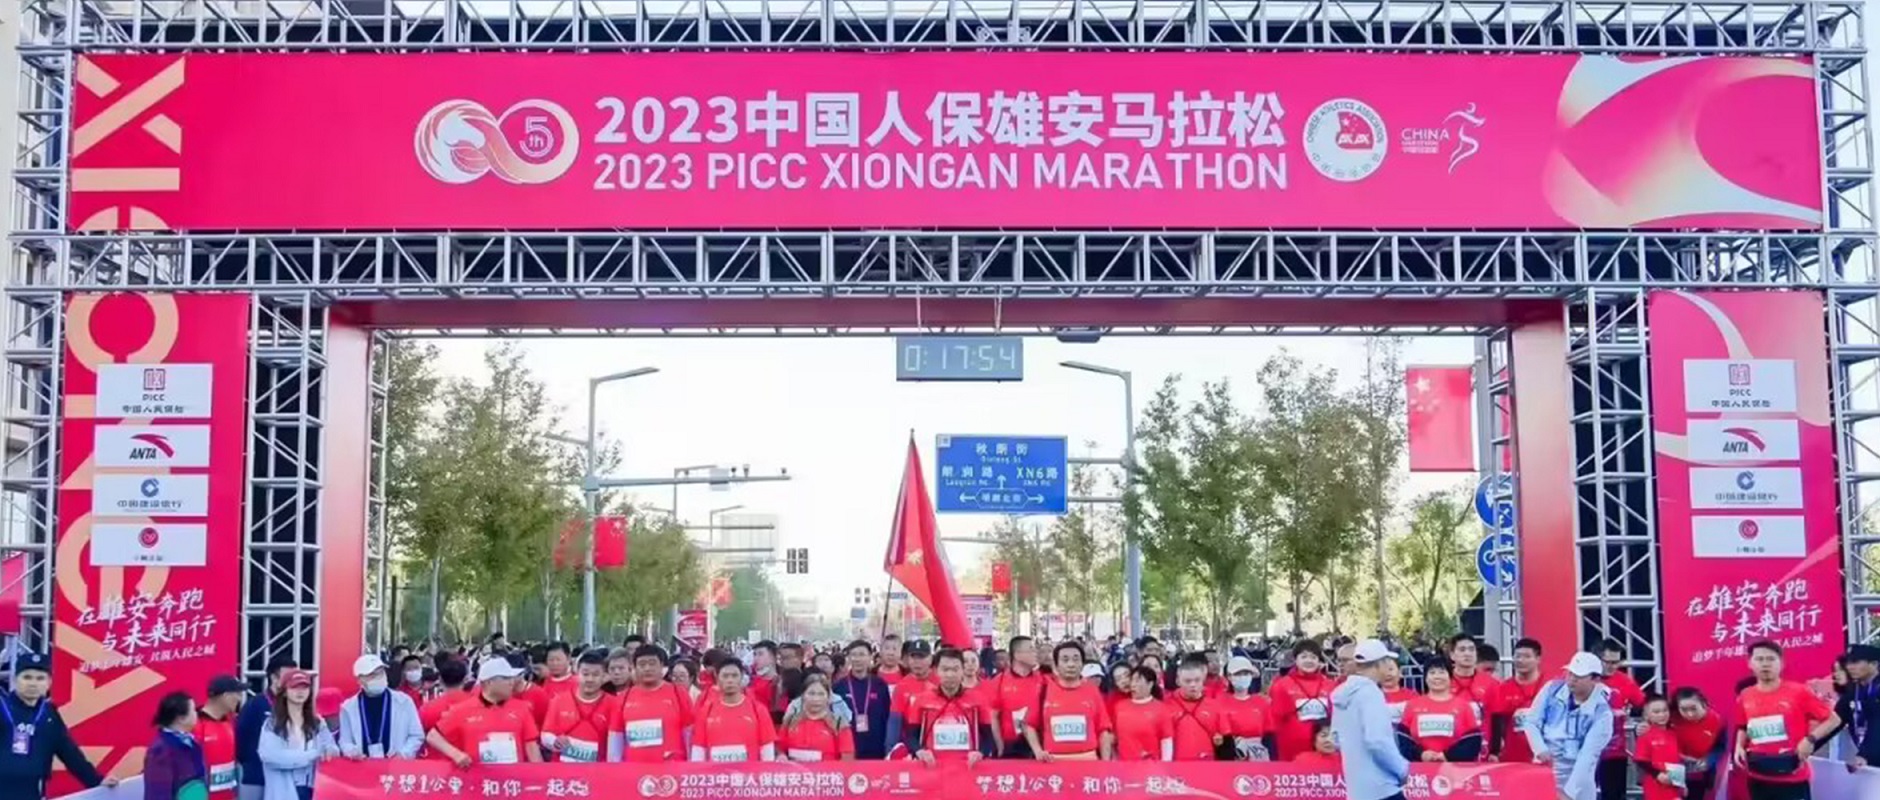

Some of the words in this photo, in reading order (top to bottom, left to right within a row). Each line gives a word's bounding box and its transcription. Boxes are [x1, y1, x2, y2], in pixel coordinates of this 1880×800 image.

[593, 90, 1286, 148] 2023中国人保雄安马拉松
[1401, 127, 1450, 141] CHINA
[593, 153, 693, 191] 2023
[707, 153, 807, 190] PICC
[819, 153, 1019, 191] XIONGAN
[1033, 153, 1288, 190] MARATHON
[904, 345, 1016, 371] 0:17:54
[129, 447, 157, 460] ANTA
[1722, 442, 1749, 453] ANTA
[76, 587, 204, 629] 在雄安奔跑
[1685, 579, 1809, 620] 在雄安奔跑
[102, 614, 217, 653] 与未来同行
[1711, 604, 1823, 644] 与未来同行
[680, 773, 844, 787] 2023中国人保雄安马拉松
[680, 788, 704, 798] 2023
[706, 788, 732, 798] PICC
[783, 787, 845, 798] MARATHON
